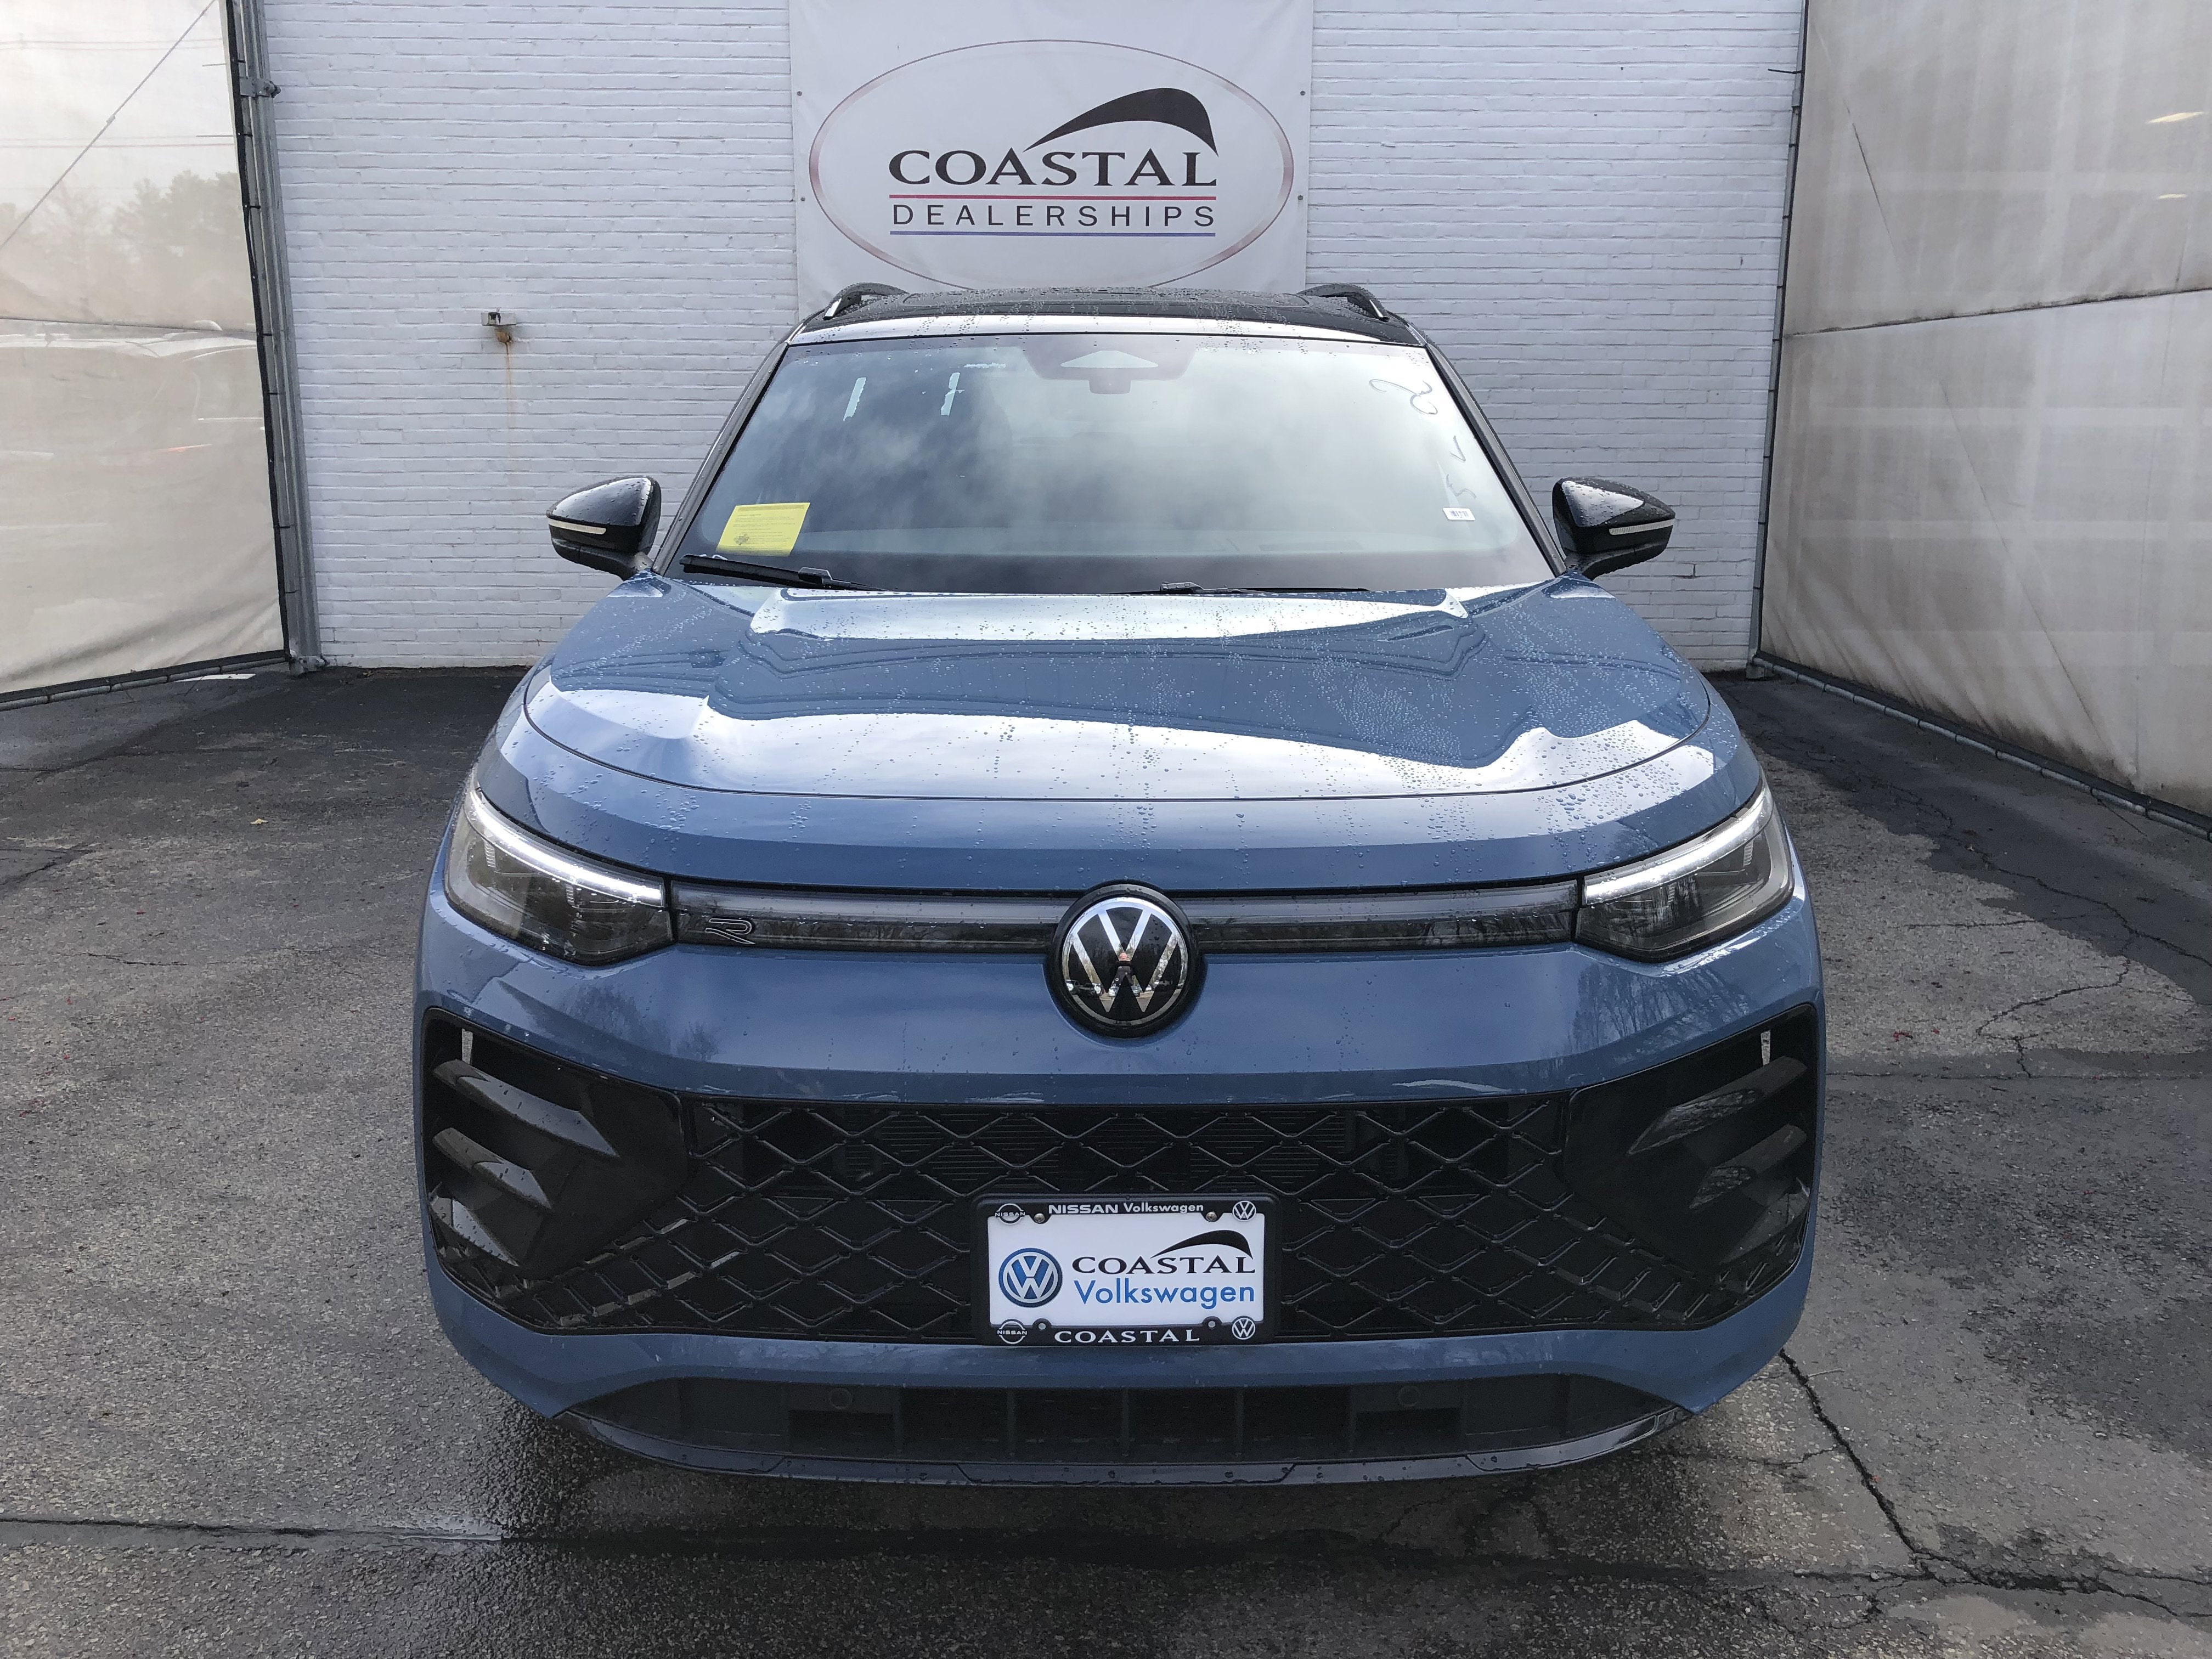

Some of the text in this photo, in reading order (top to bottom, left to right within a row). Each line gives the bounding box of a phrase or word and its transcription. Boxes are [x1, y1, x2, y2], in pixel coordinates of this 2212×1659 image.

[888, 147, 1217, 187] COASTAL
[893, 204, 1214, 228] DEALERSHIPS
[1048, 1203, 1204, 1214] NISSAN Volkswagen
[1072, 1255, 1256, 1274] COASTAL
[1074, 1277, 1255, 1310] Volkswagen
[1054, 1329, 1200, 1344] COASTAL
